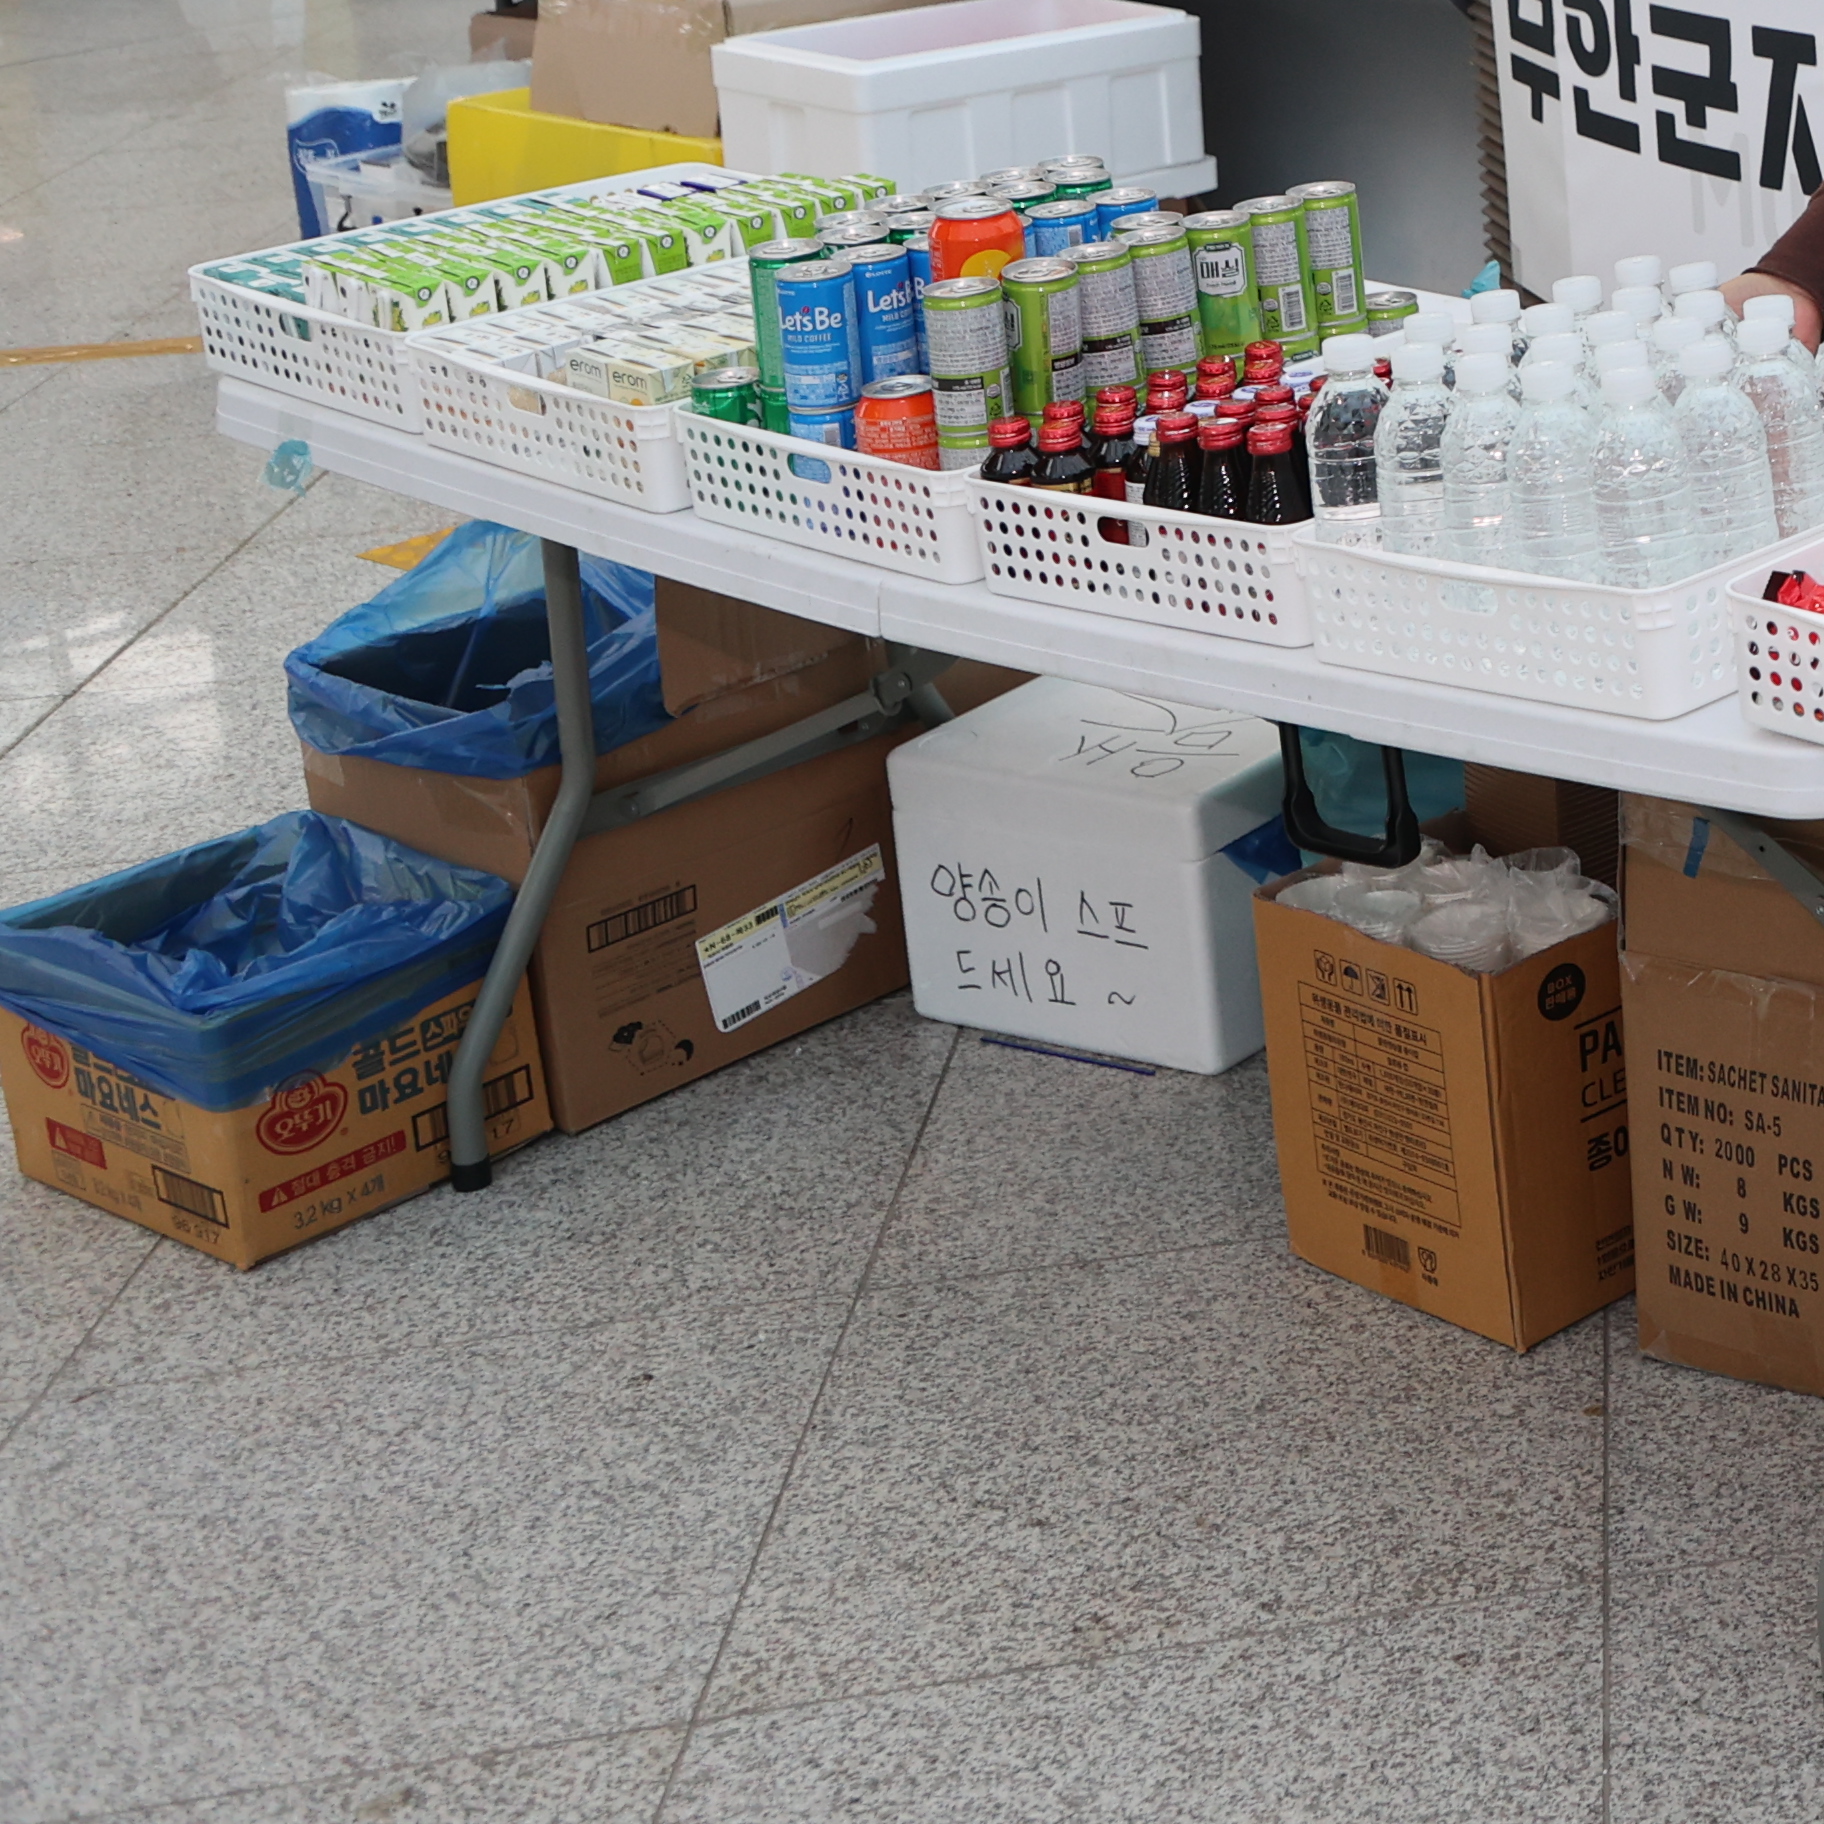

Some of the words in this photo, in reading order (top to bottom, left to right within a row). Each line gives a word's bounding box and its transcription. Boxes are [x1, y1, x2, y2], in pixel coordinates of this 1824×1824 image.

[815, 307, 843, 329] Be
[569, 356, 601, 377] erom
[612, 371, 648, 390] erom
[930, 861, 1050, 933] 양송이
[956, 949, 1077, 1007] 드세요
[357, 1051, 454, 1116] 마요네
[1657, 1049, 1704, 1084] ITEM:
[1706, 1057, 1767, 1096] SACHET
[273, 1100, 333, 1142] 오뚜기
[1658, 1086, 1700, 1118] ITEM
[1702, 1094, 1735, 1127] NO:
[1744, 1105, 1783, 1138] SA-5
[1660, 1126, 1706, 1158] QTY:
[1713, 1136, 1757, 1170] 2000
[1777, 1149, 1814, 1183] PCS
[291, 1172, 322, 1198] 절대
[321, 1196, 344, 1217] kg
[1736, 1177, 1747, 1200] 8
[1782, 1187, 1822, 1221] KGS
[1666, 1231, 1711, 1264] SIZE:
[1738, 1212, 1749, 1236] 9
[1782, 1224, 1821, 1257] KGS
[1669, 1264, 1715, 1301] MADE
[1718, 1276, 1738, 1304] IN
[1742, 1278, 1801, 1319] CHINA
